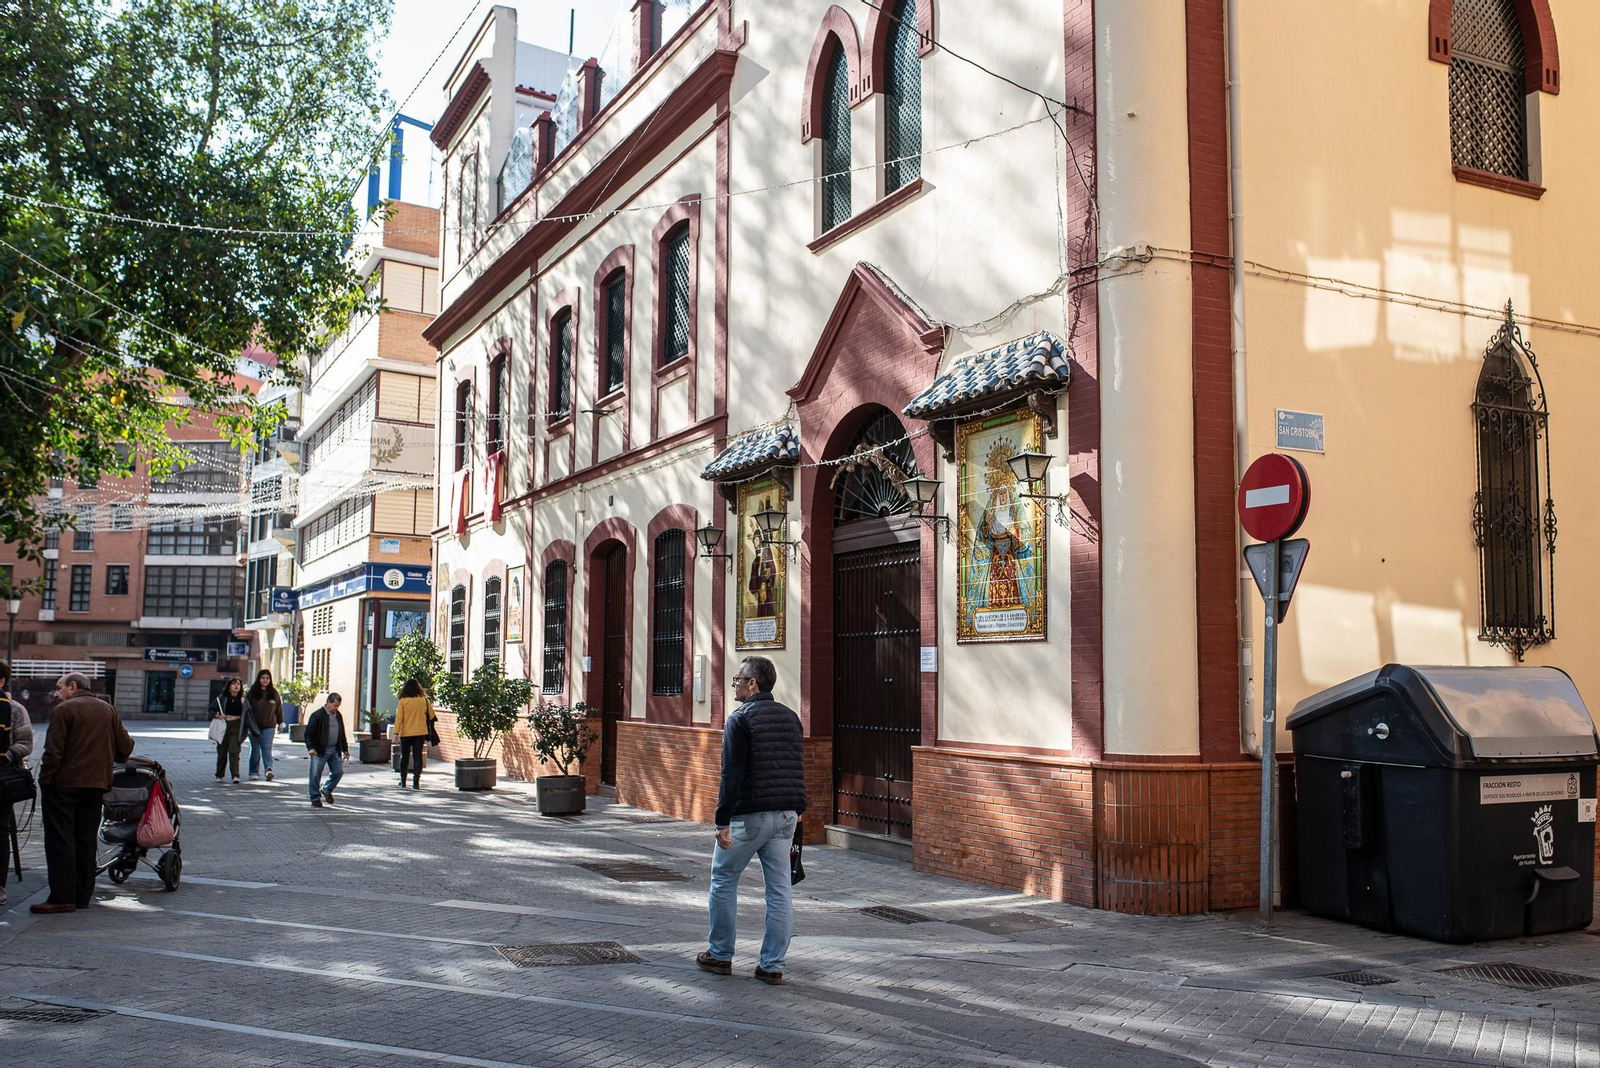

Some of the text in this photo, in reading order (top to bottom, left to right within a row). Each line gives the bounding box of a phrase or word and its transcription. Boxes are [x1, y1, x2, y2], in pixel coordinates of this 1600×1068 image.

[1279, 426, 1289, 435] SAN
[1483, 781, 1506, 789] FRACCIÓN
[1513, 853, 1536, 861] Ayuntamiento
